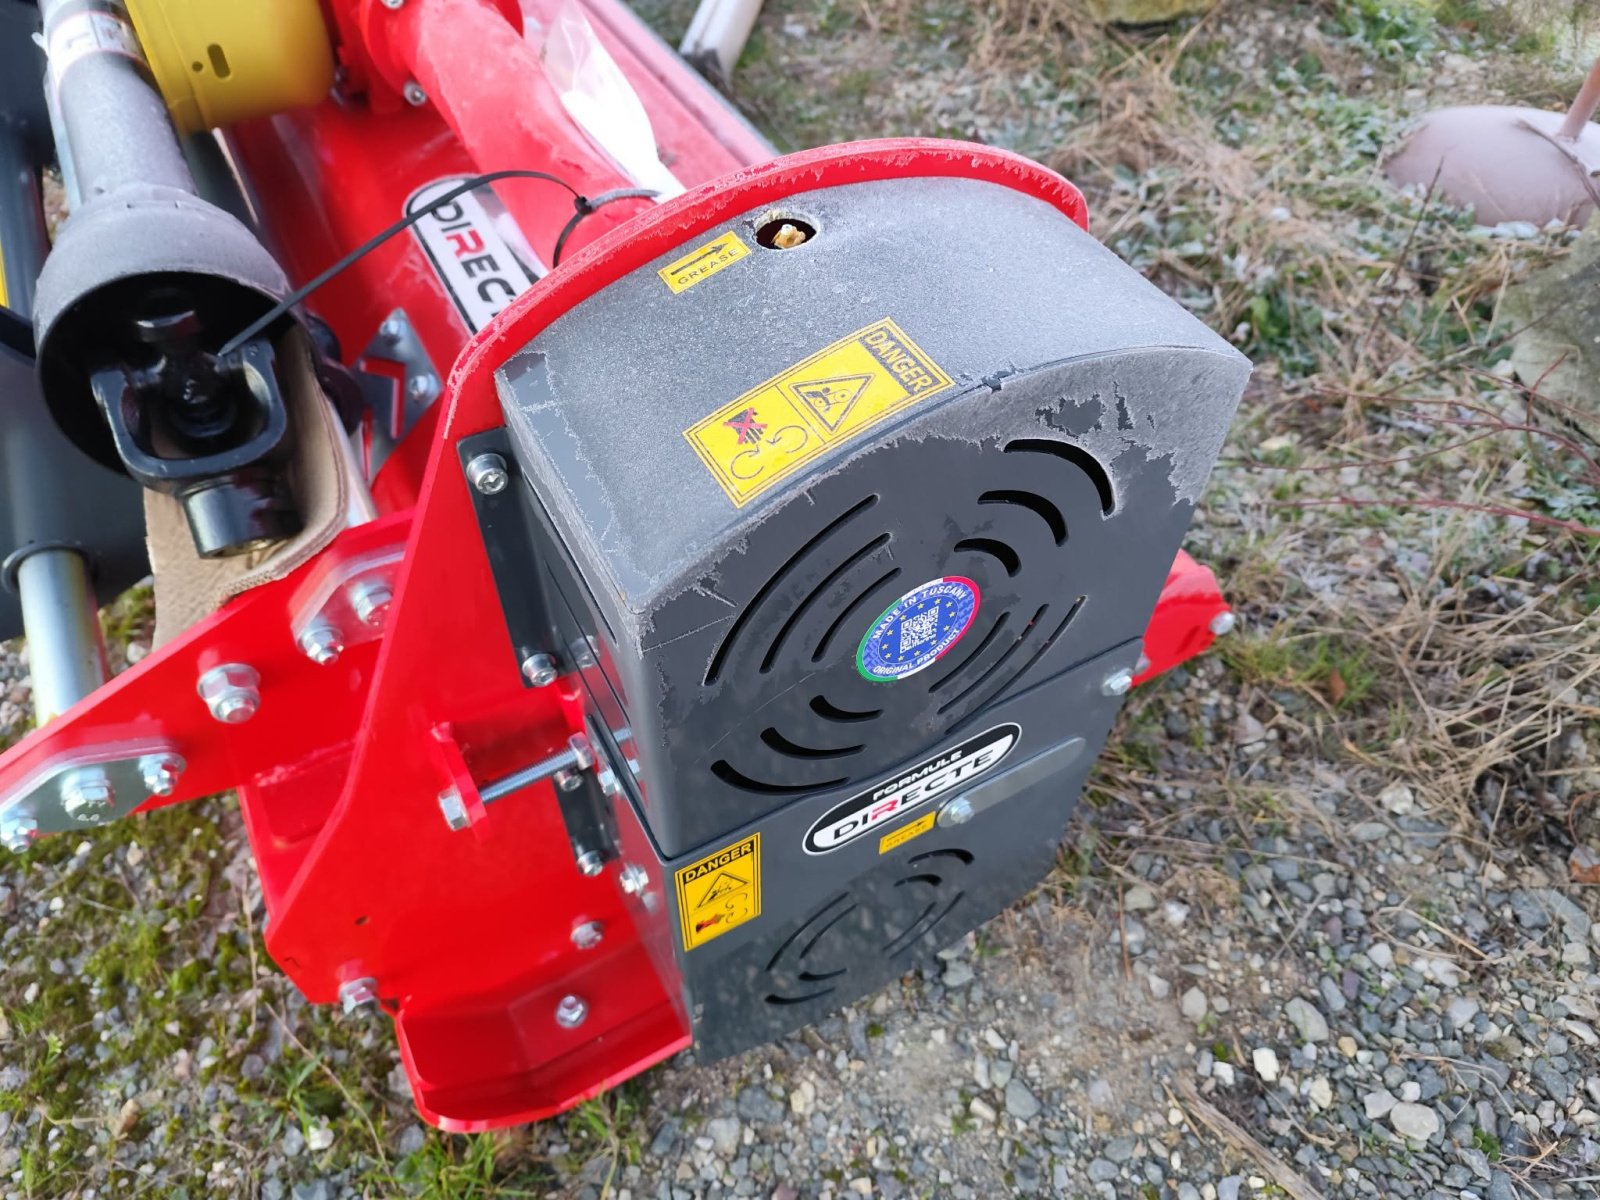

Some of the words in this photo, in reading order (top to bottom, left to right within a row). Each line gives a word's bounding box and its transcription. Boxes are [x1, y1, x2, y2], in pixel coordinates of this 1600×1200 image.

[431, 199, 517, 317] DIREC
[677, 248, 738, 285] GREASE
[864, 328, 933, 392] DANGER
[873, 608, 901, 639] MADE
[904, 597, 917, 608] IN
[922, 585, 967, 600] TUSCANY
[873, 662, 914, 675] ORIGINAL
[916, 629, 960, 665] PRODUCT
[833, 749, 994, 840] DIRECTE
[872, 750, 963, 801] FORMULE
[684, 842, 752, 883] DANGER
